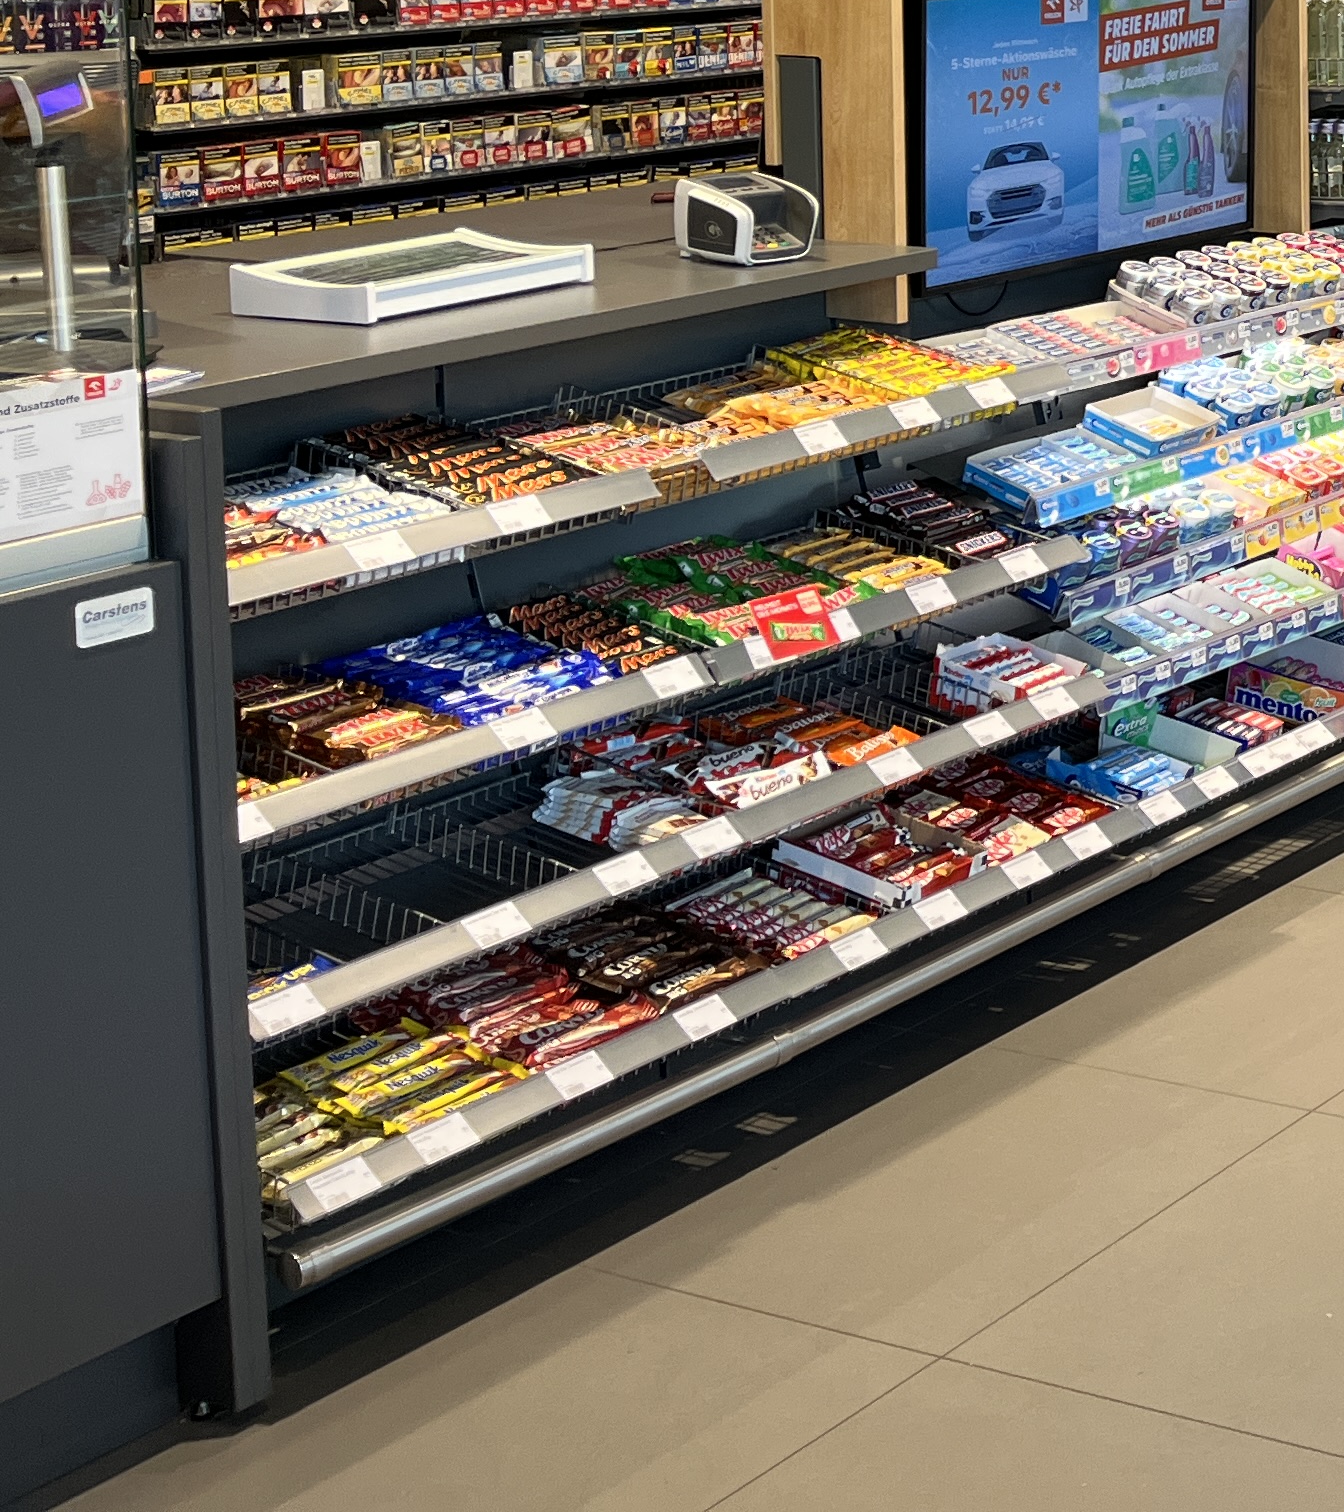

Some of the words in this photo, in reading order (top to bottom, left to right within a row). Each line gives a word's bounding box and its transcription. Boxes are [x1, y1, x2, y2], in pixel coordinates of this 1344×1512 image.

[1104, 14, 1143, 40] FREIE
[1144, 7, 1186, 33] FAHRT
[950, 46, 1078, 70] 5-Sterne-Aktionswäsche
[1104, 39, 1131, 65] FÜR
[1133, 35, 1159, 59] DEN
[1162, 26, 1215, 54] SOMMER
[1002, 66, 1030, 81] NUR
[1166, 70, 1178, 82] der
[967, 84, 1031, 117] 12,99
[206, 184, 241, 196] BURTON
[285, 173, 320, 185] BURTON
[162, 188, 199, 200] BURTON
[1145, 215, 1167, 229] MEHR
[1168, 211, 1182, 223] ALS
[1183, 202, 1214, 219] GÜNSTIG
[1215, 193, 1245, 209] TANKEN!
[14, 393, 81, 415] Zusatzstoffe
[477, 458, 553, 493] Mars
[491, 469, 567, 503] Mars
[963, 531, 1003, 551] SNICKERS
[82, 598, 147, 625] Carstens
[509, 595, 568, 624] Mars
[620, 645, 679, 674] Mars
[1113, 715, 1149, 738] extra
[709, 744, 756, 768] bueno
[750, 774, 794, 800] bueno
[327, 1038, 382, 1064] Nesquik
[388, 1065, 443, 1091] Nesquik
